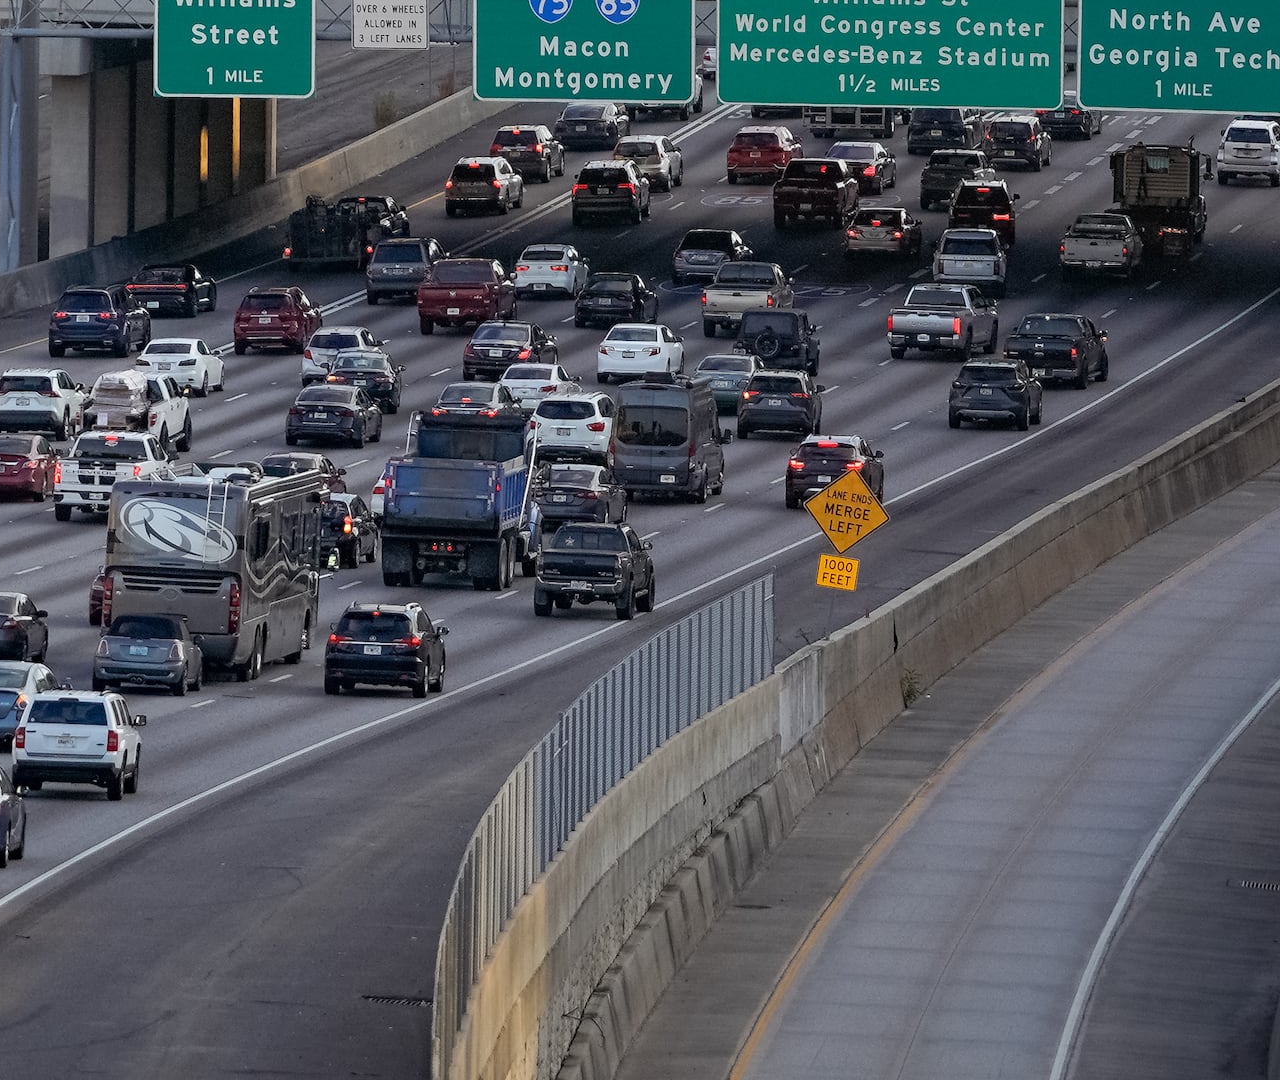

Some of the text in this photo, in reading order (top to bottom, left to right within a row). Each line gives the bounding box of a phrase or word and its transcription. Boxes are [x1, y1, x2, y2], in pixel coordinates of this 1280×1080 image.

[356, 4, 425, 14] OVER 6 WHEELS
[364, 19, 417, 29] ALLOWED IN
[735, 13, 1045, 40] World Congress Center
[1109, 8, 1261, 34] North Ave
[191, 23, 279, 46] Street
[359, 34, 422, 43] 3 LEFT LANES
[539, 35, 629, 57] Macon
[730, 43, 1050, 67] Mercedes-Benz Stadium
[1088, 43, 1280, 73] Georgia Tech
[206, 66, 263, 85] 1 MILE
[495, 67, 673, 95] Montgomery
[891, 78, 940, 92] MILES
[1155, 79, 1213, 98] 1 MILE
[826, 488, 873, 505] LANE ENDS
[824, 502, 871, 521] MERGE
[829, 519, 863, 536] LEFT
[824, 558, 853, 573] 1000
[822, 572, 852, 586] FEET
